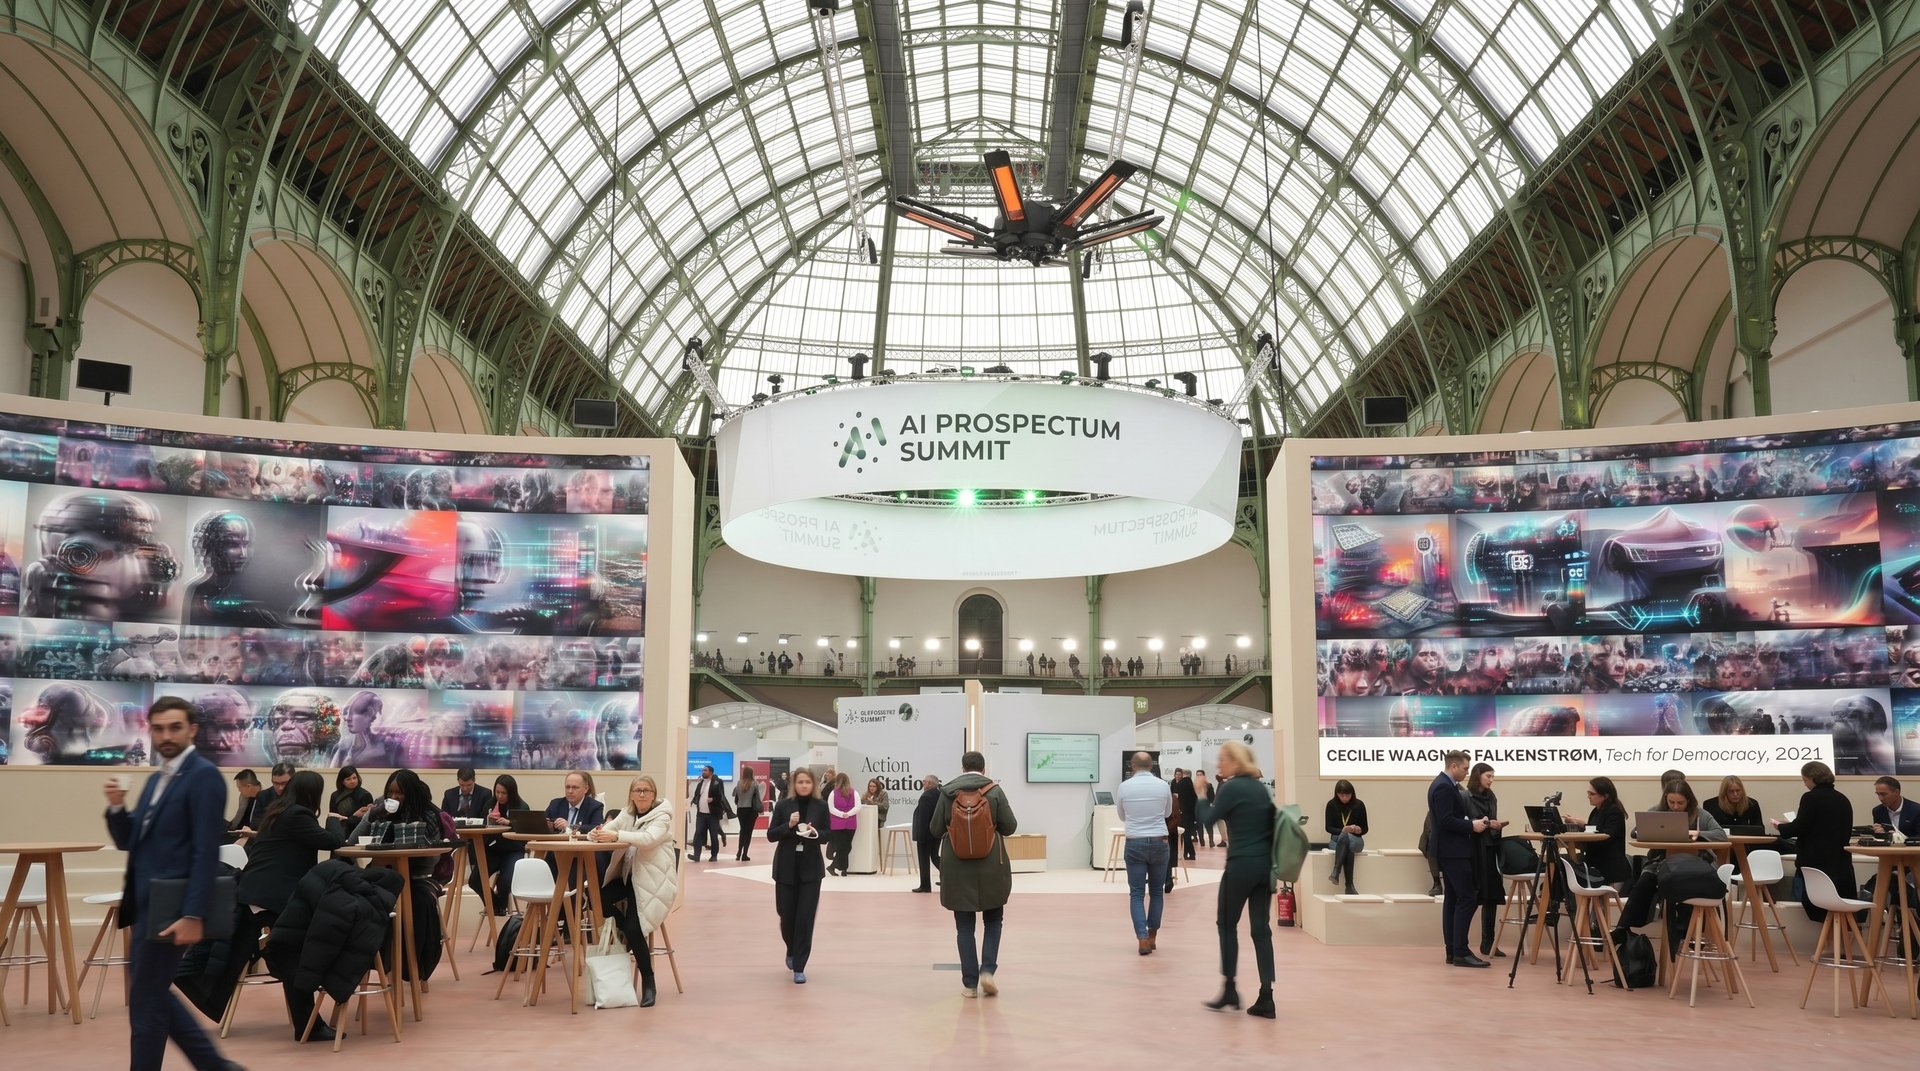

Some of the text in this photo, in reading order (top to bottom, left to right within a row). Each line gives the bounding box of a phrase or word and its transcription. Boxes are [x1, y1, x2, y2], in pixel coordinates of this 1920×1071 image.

[900, 413, 1121, 440] AI PROSPECTUM
[900, 440, 1010, 461] SUMMIT
[860, 715, 886, 723] SUMMIT
[1327, 749, 1385, 762] CECILIE
[1475, 748, 1602, 764] FALKENSTRØM,
[1606, 748, 1642, 762] Tech
[1646, 747, 1669, 762] for
[1672, 748, 1770, 764] Democracy,
[1775, 747, 1823, 761] 2021
[861, 756, 910, 773] Action
